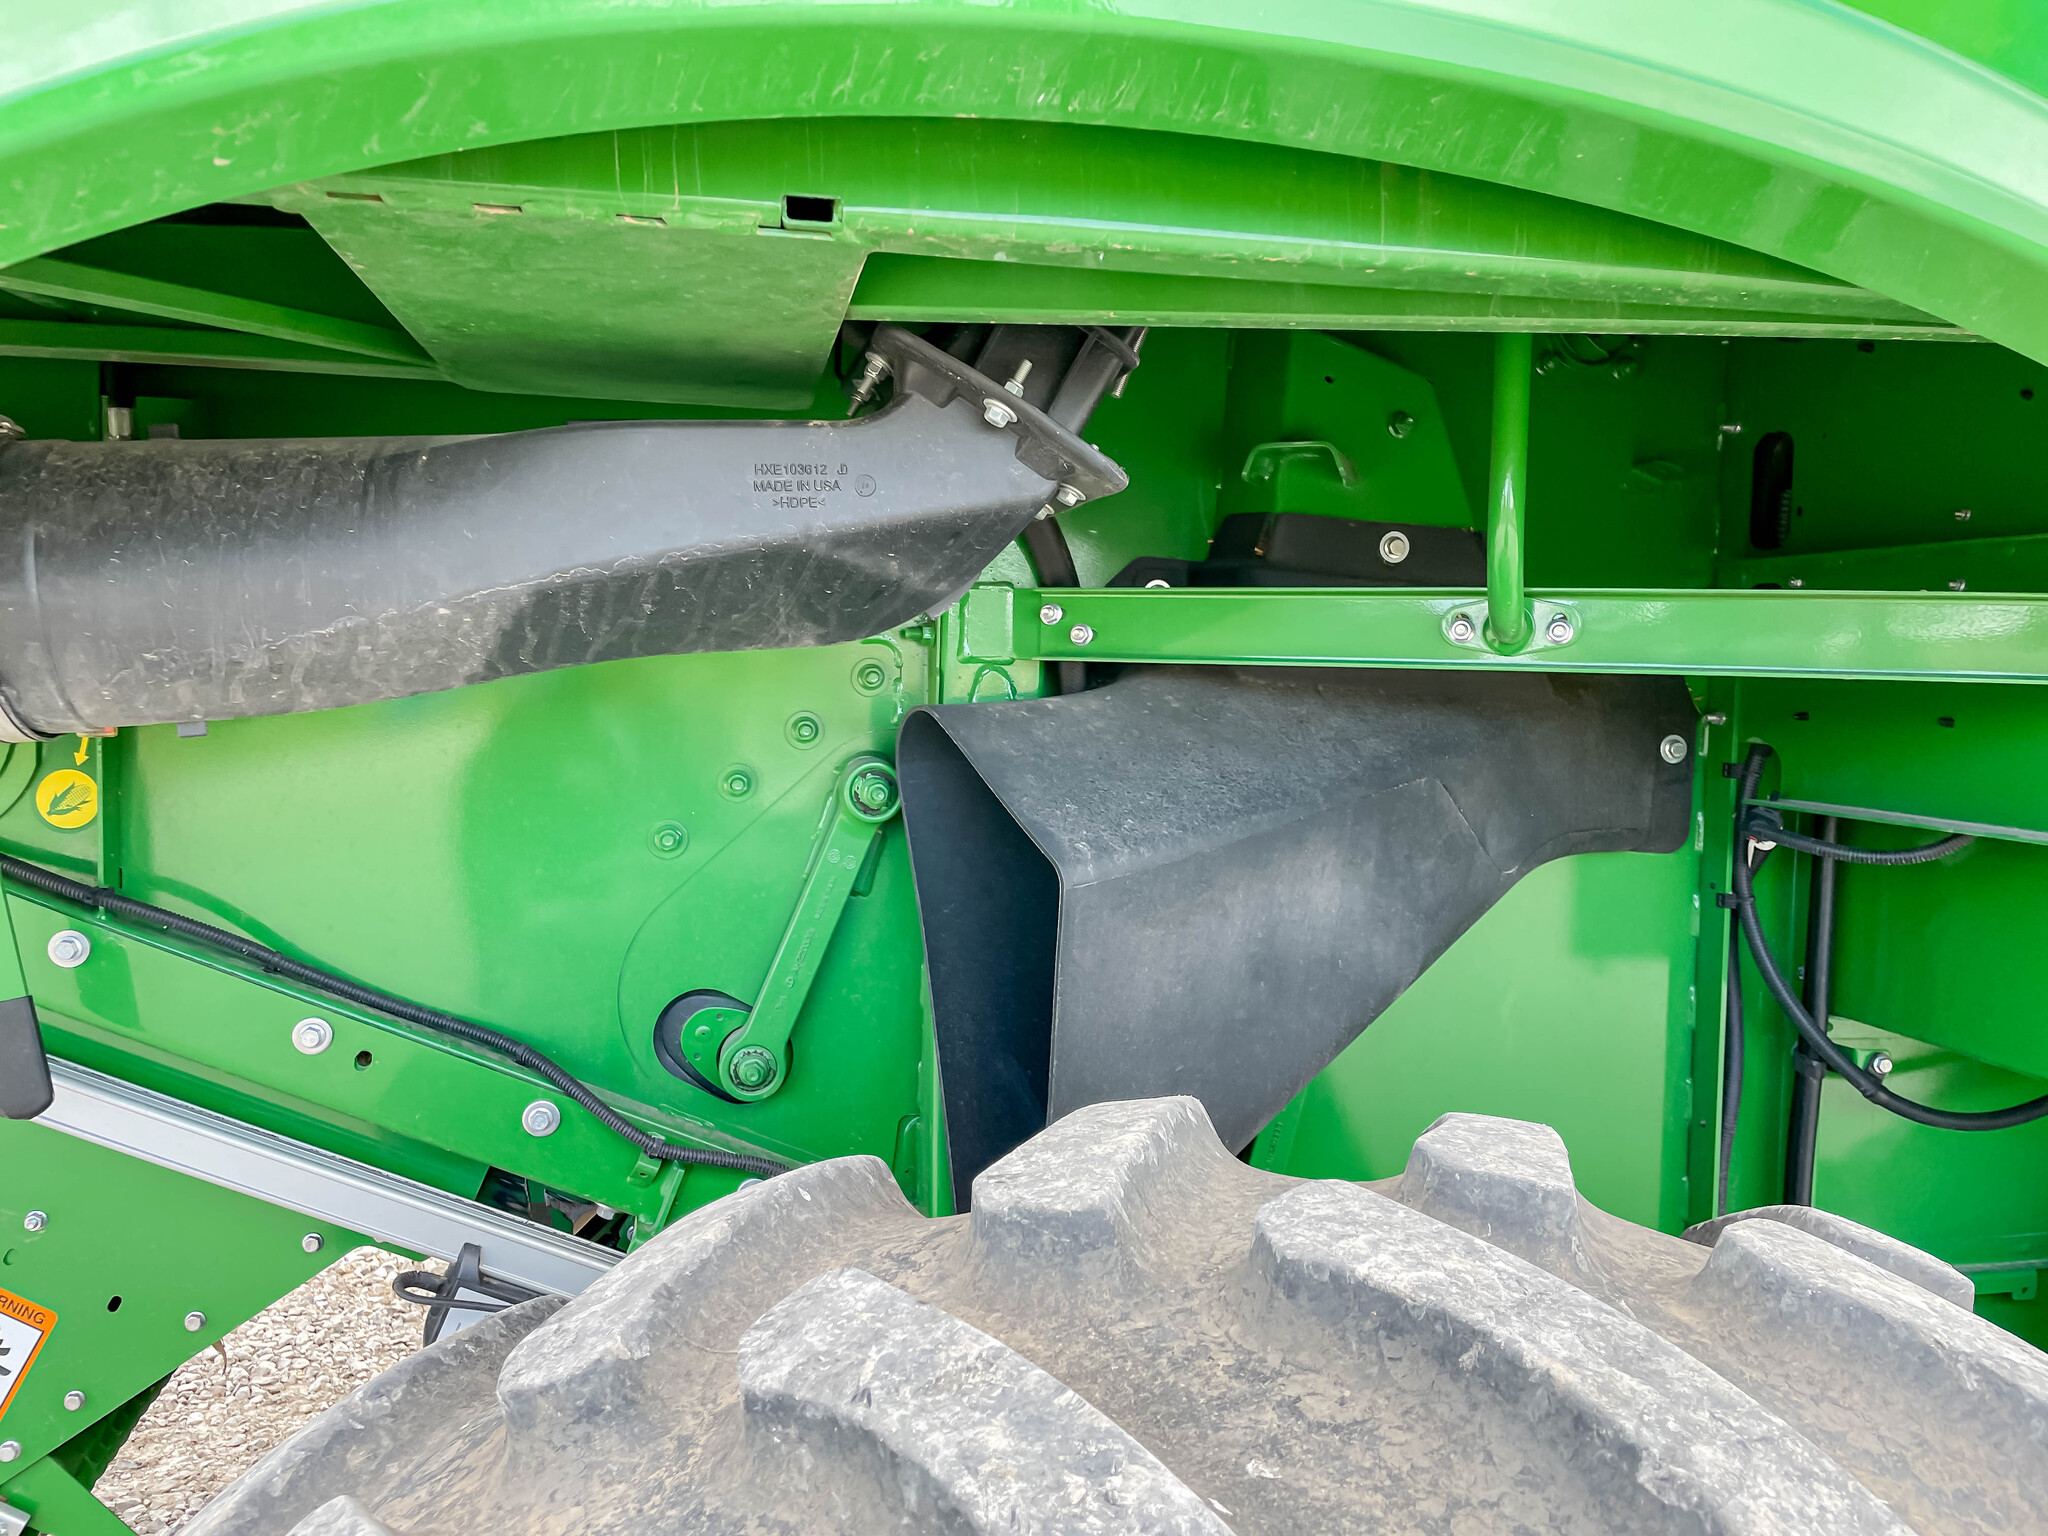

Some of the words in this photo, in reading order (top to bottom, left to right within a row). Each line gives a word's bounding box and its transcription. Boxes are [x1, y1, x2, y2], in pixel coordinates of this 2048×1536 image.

[753, 480, 793, 492] MADE
[796, 480, 810, 492] IN
[813, 479, 842, 492] USA
